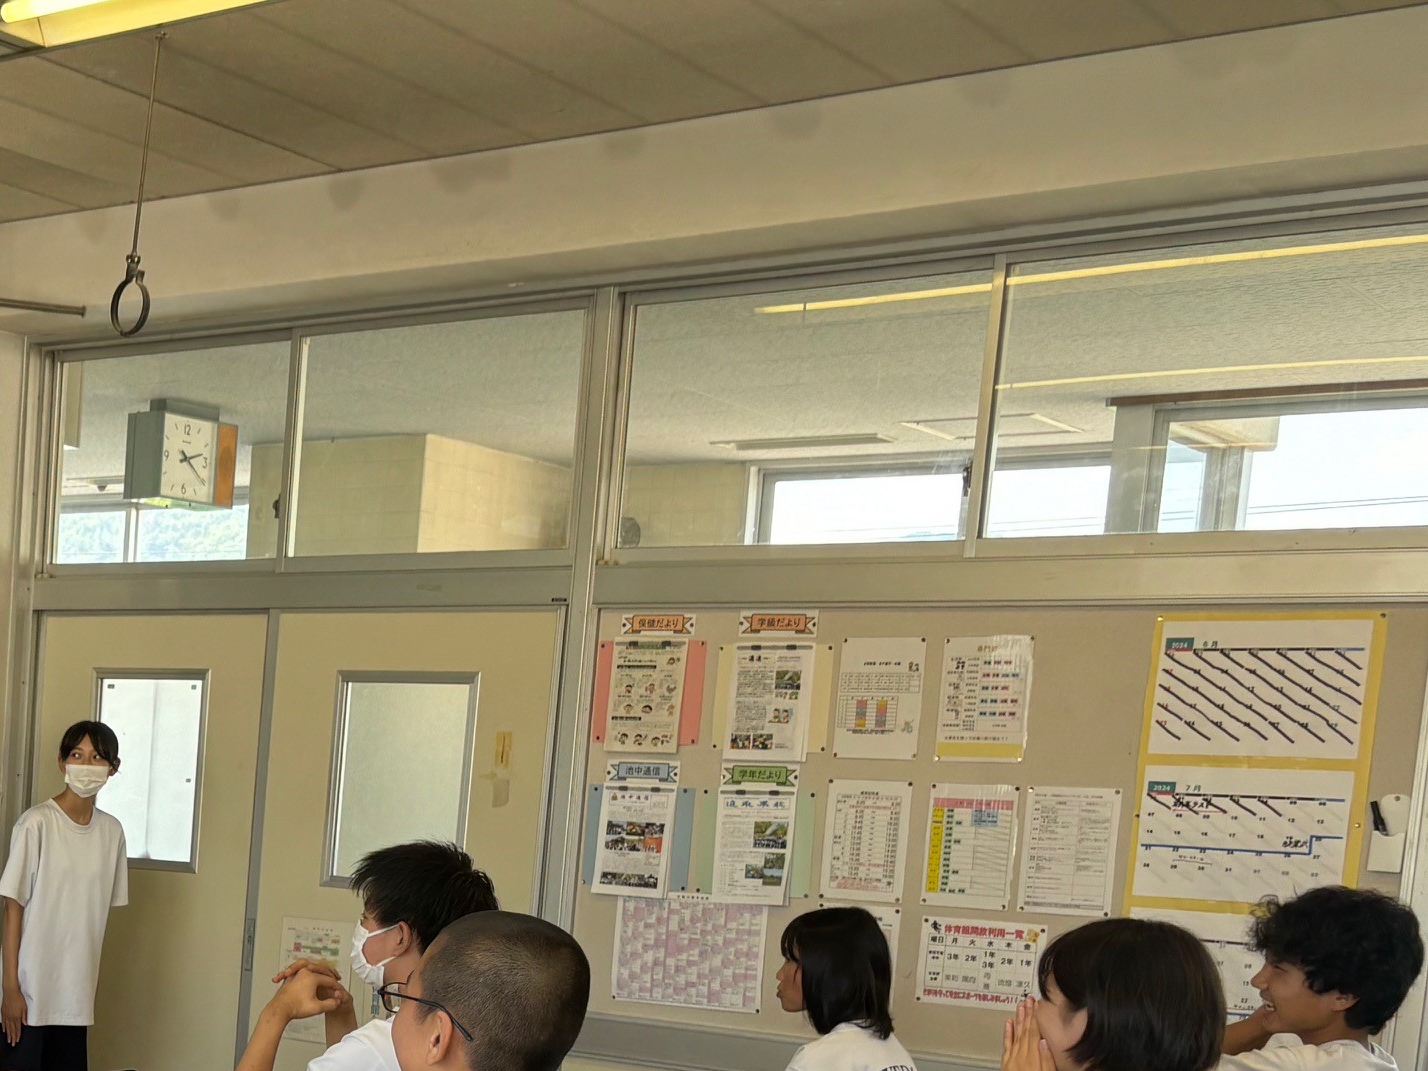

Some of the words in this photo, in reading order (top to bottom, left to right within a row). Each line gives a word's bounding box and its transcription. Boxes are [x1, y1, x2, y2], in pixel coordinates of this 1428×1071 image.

[183, 423, 192, 436] 12
[163, 449, 169, 461] 9
[202, 456, 209, 469] 3
[180, 483, 187, 495] 6
[638, 618, 679, 629] 保健だより
[758, 617, 801, 629] 学級だより
[625, 765, 661, 777] 池中通信
[739, 769, 782, 781] 学年だより
[944, 924, 1024, 939] 体育館開放利用一覧
